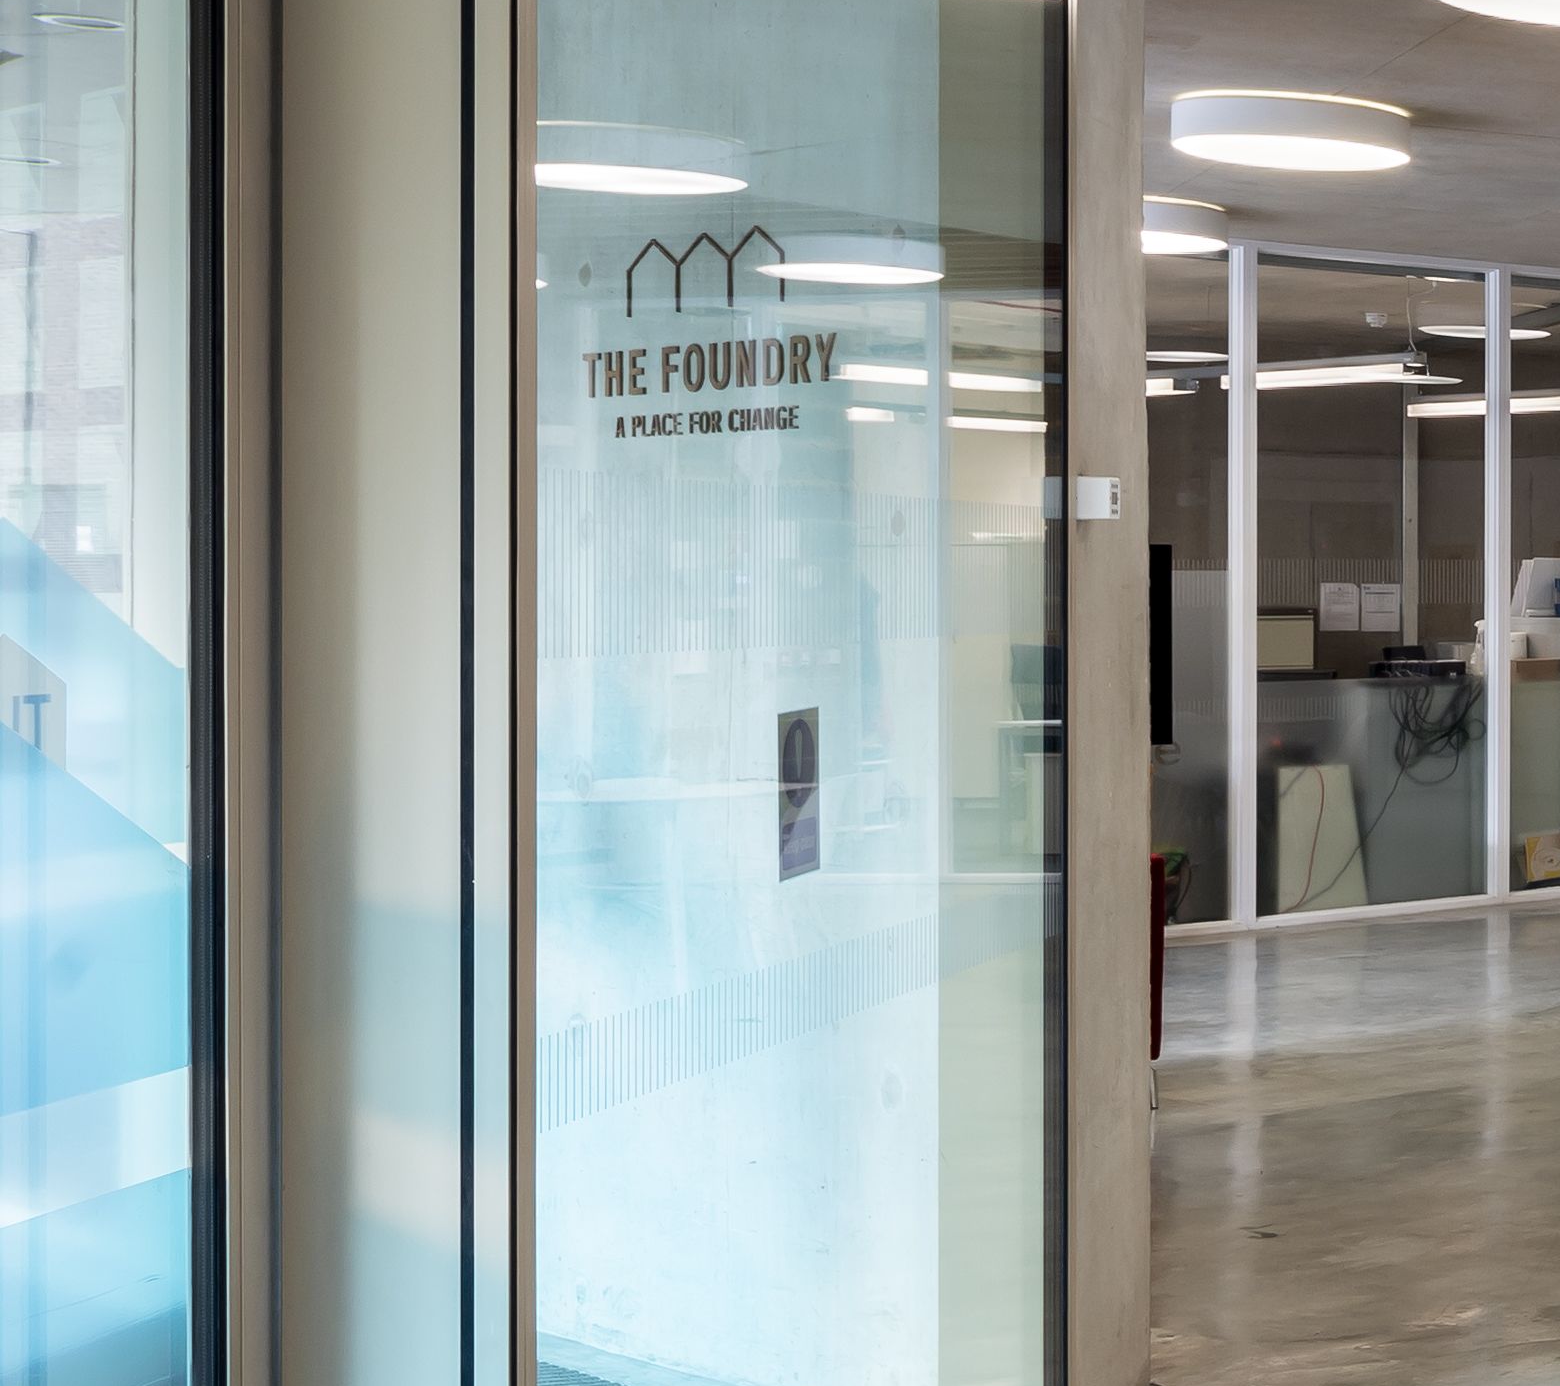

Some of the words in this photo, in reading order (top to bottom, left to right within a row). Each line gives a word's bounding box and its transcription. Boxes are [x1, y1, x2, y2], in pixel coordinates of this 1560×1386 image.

[582, 348, 647, 398] THE
[661, 332, 837, 393] FOUNDRY
[615, 416, 626, 438] A
[631, 412, 683, 438] PLACE
[689, 410, 722, 434] FOR
[728, 405, 800, 433] CHANGE
